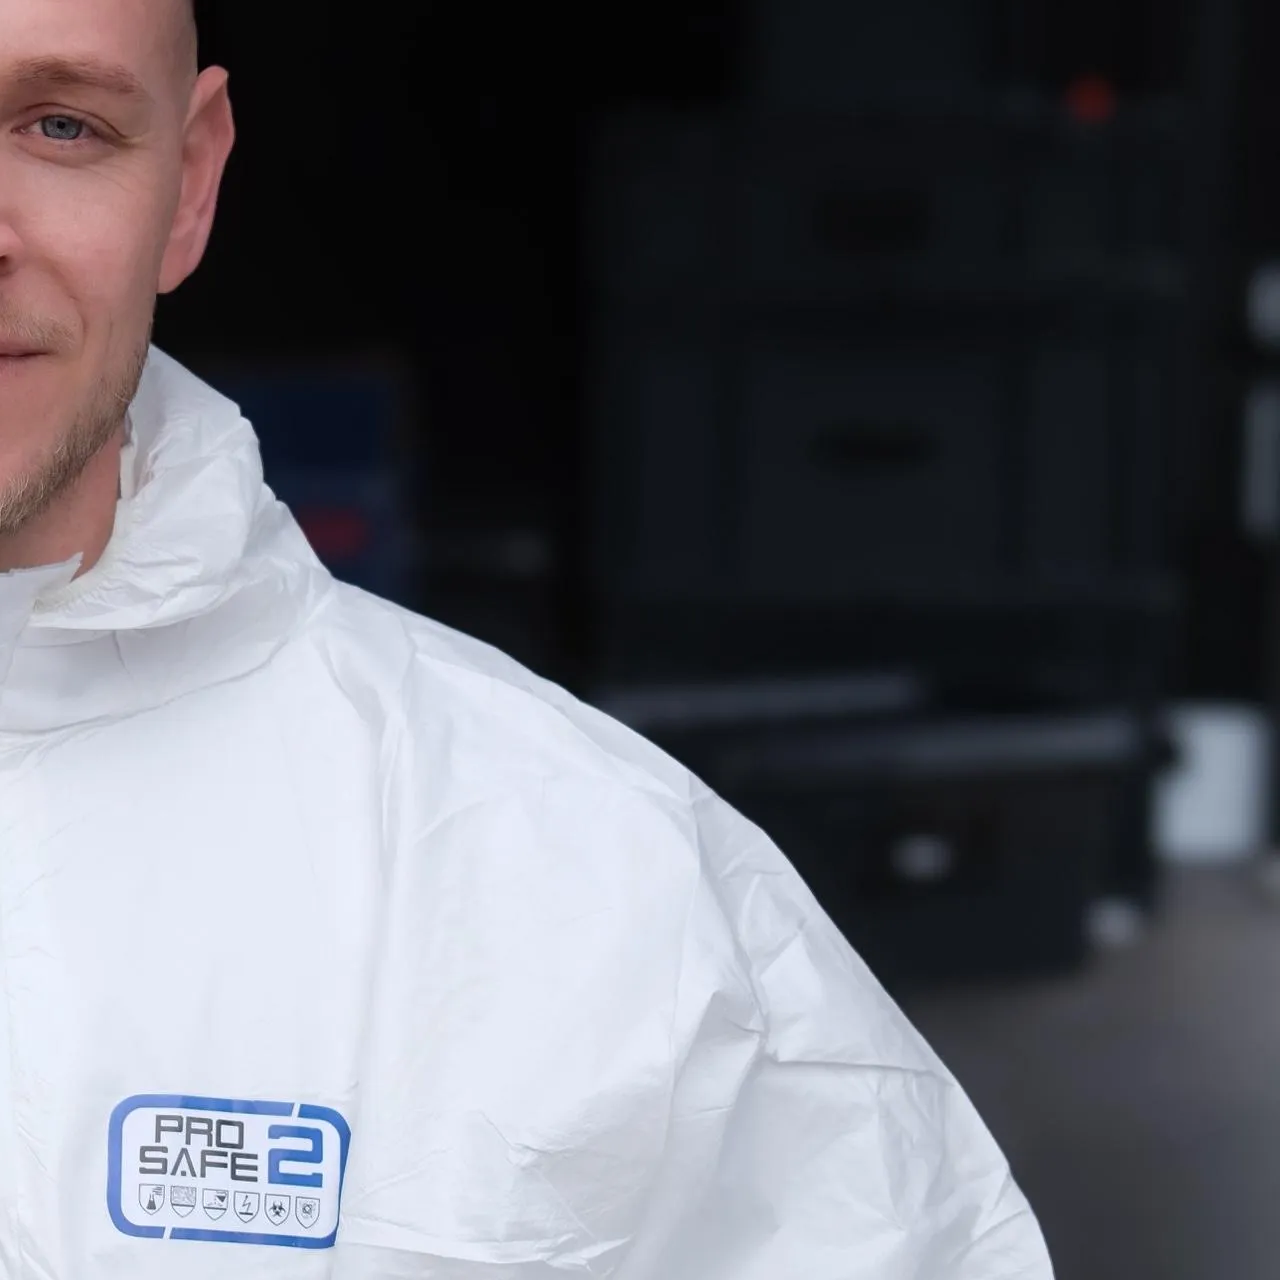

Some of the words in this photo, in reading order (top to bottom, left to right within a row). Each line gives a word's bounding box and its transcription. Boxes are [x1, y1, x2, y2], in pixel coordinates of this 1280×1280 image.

[154, 1114, 244, 1150] PRO
[138, 1145, 258, 1183] SAFE
[267, 1124, 323, 1188] 2
